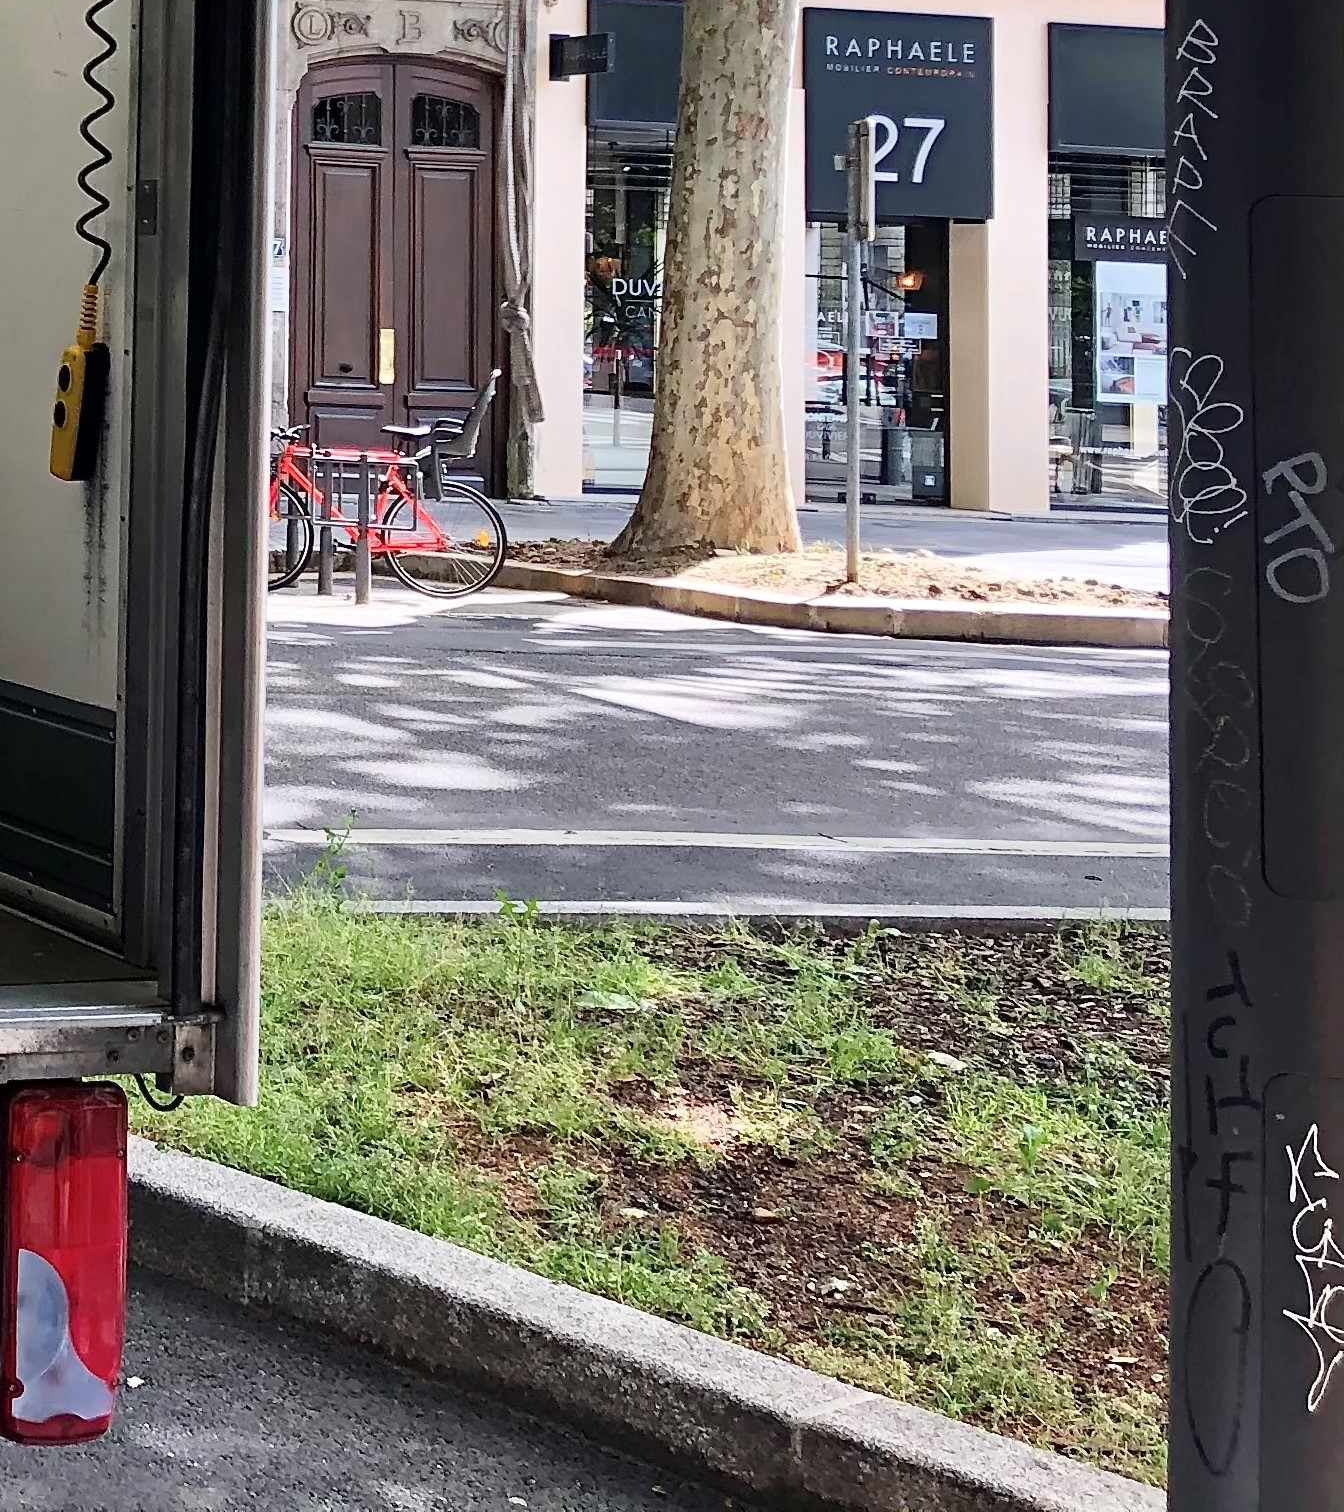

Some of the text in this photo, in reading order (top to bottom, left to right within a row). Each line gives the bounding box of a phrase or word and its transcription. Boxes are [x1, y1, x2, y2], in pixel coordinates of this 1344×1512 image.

[398, 9, 423, 44] B
[825, 35, 976, 64] RAPHAELE
[826, 63, 880, 74] MOBILIER
[866, 114, 946, 184] 27
